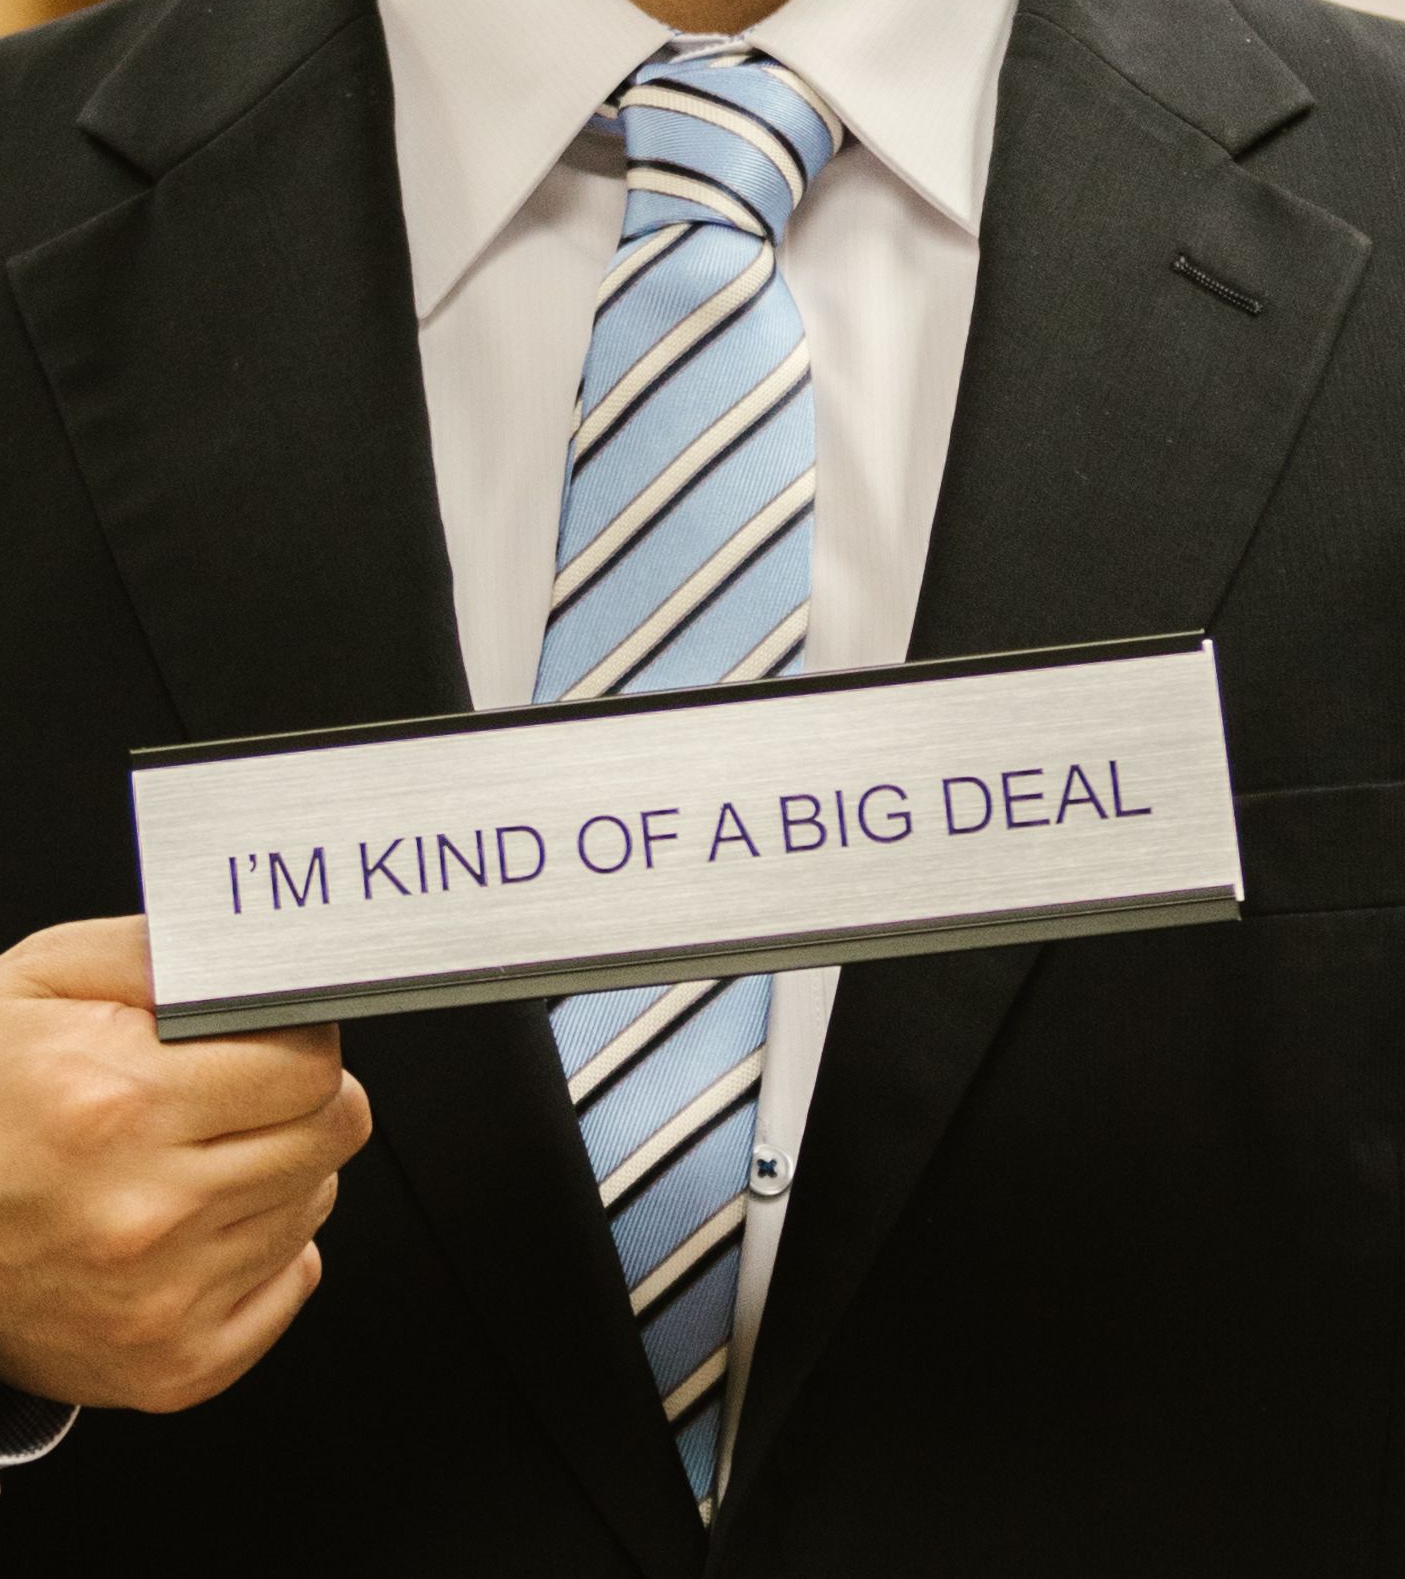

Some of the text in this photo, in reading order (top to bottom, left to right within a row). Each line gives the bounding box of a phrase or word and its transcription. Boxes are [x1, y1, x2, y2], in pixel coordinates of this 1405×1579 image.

[228, 759, 1153, 915] I'M KIND OF A BIG DEAL
